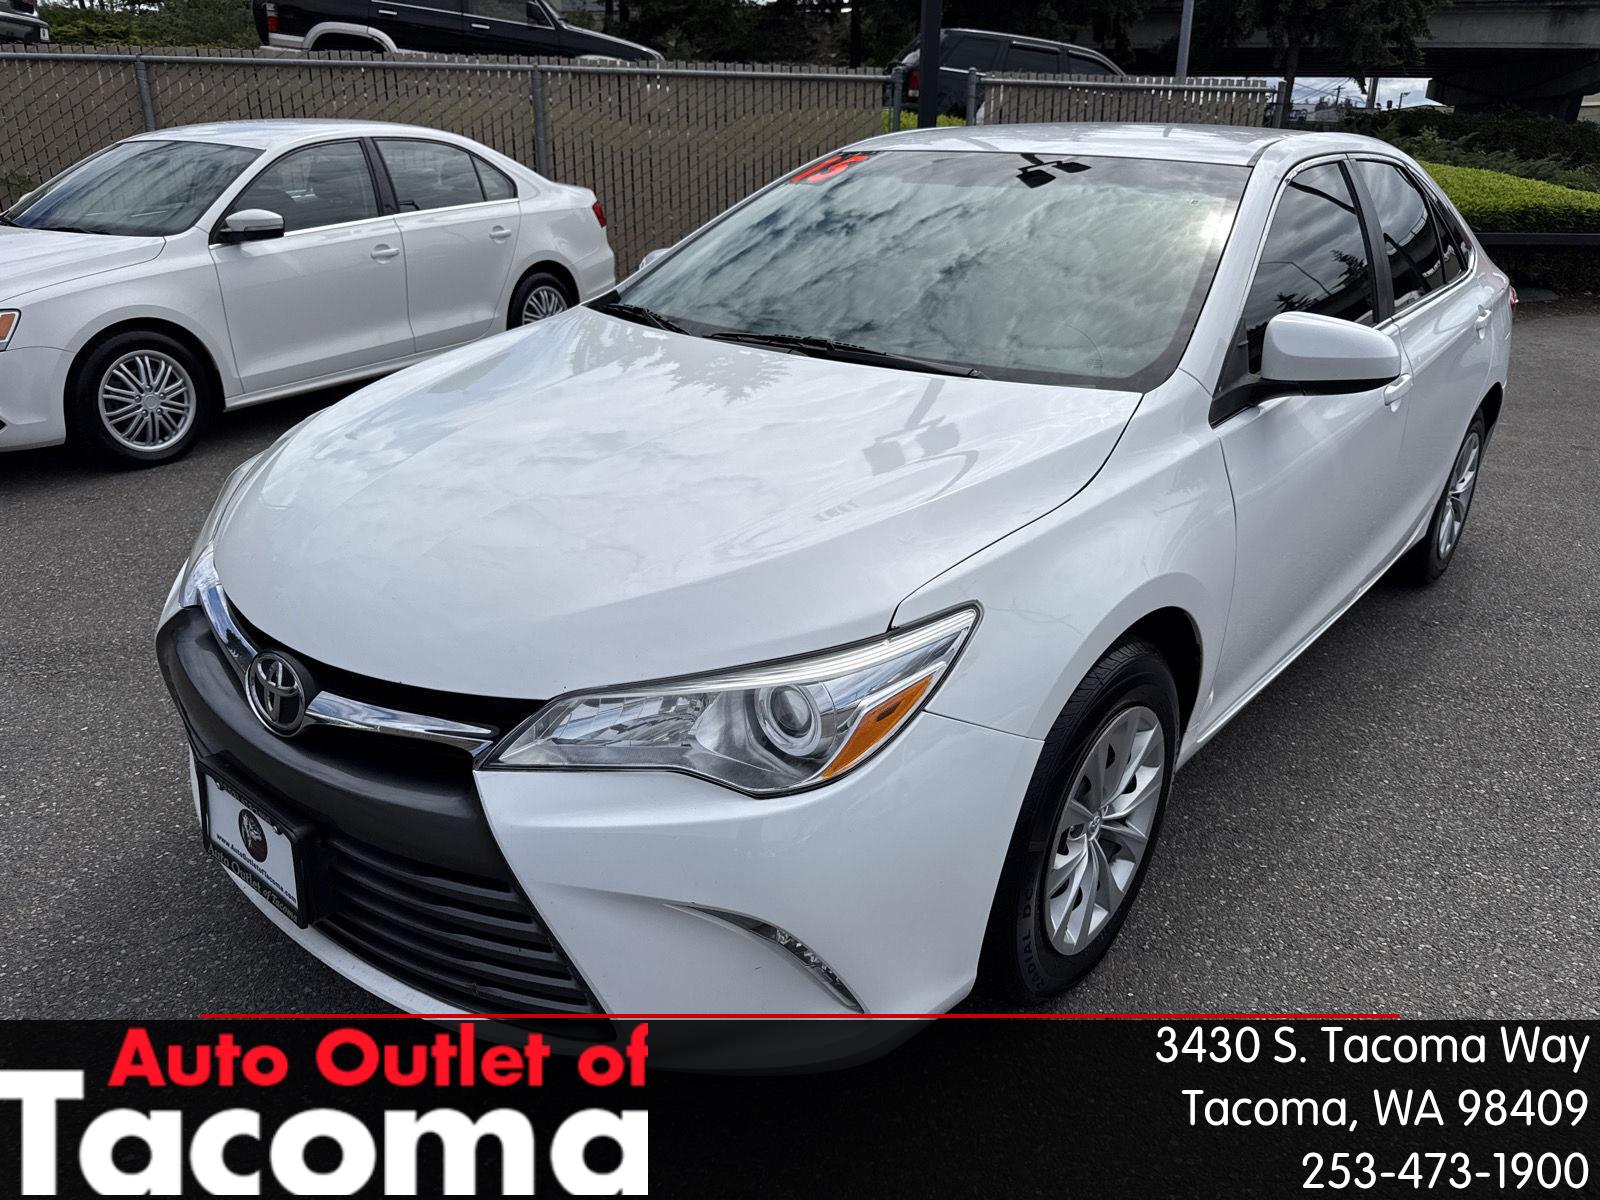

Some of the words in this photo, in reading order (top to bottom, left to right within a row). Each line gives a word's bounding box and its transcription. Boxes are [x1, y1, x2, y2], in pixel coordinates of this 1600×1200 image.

[208, 843, 229, 867] Auto
[231, 861, 261, 892] Outlet
[262, 889, 271, 900] of
[271, 893, 298, 922] Tacoma
